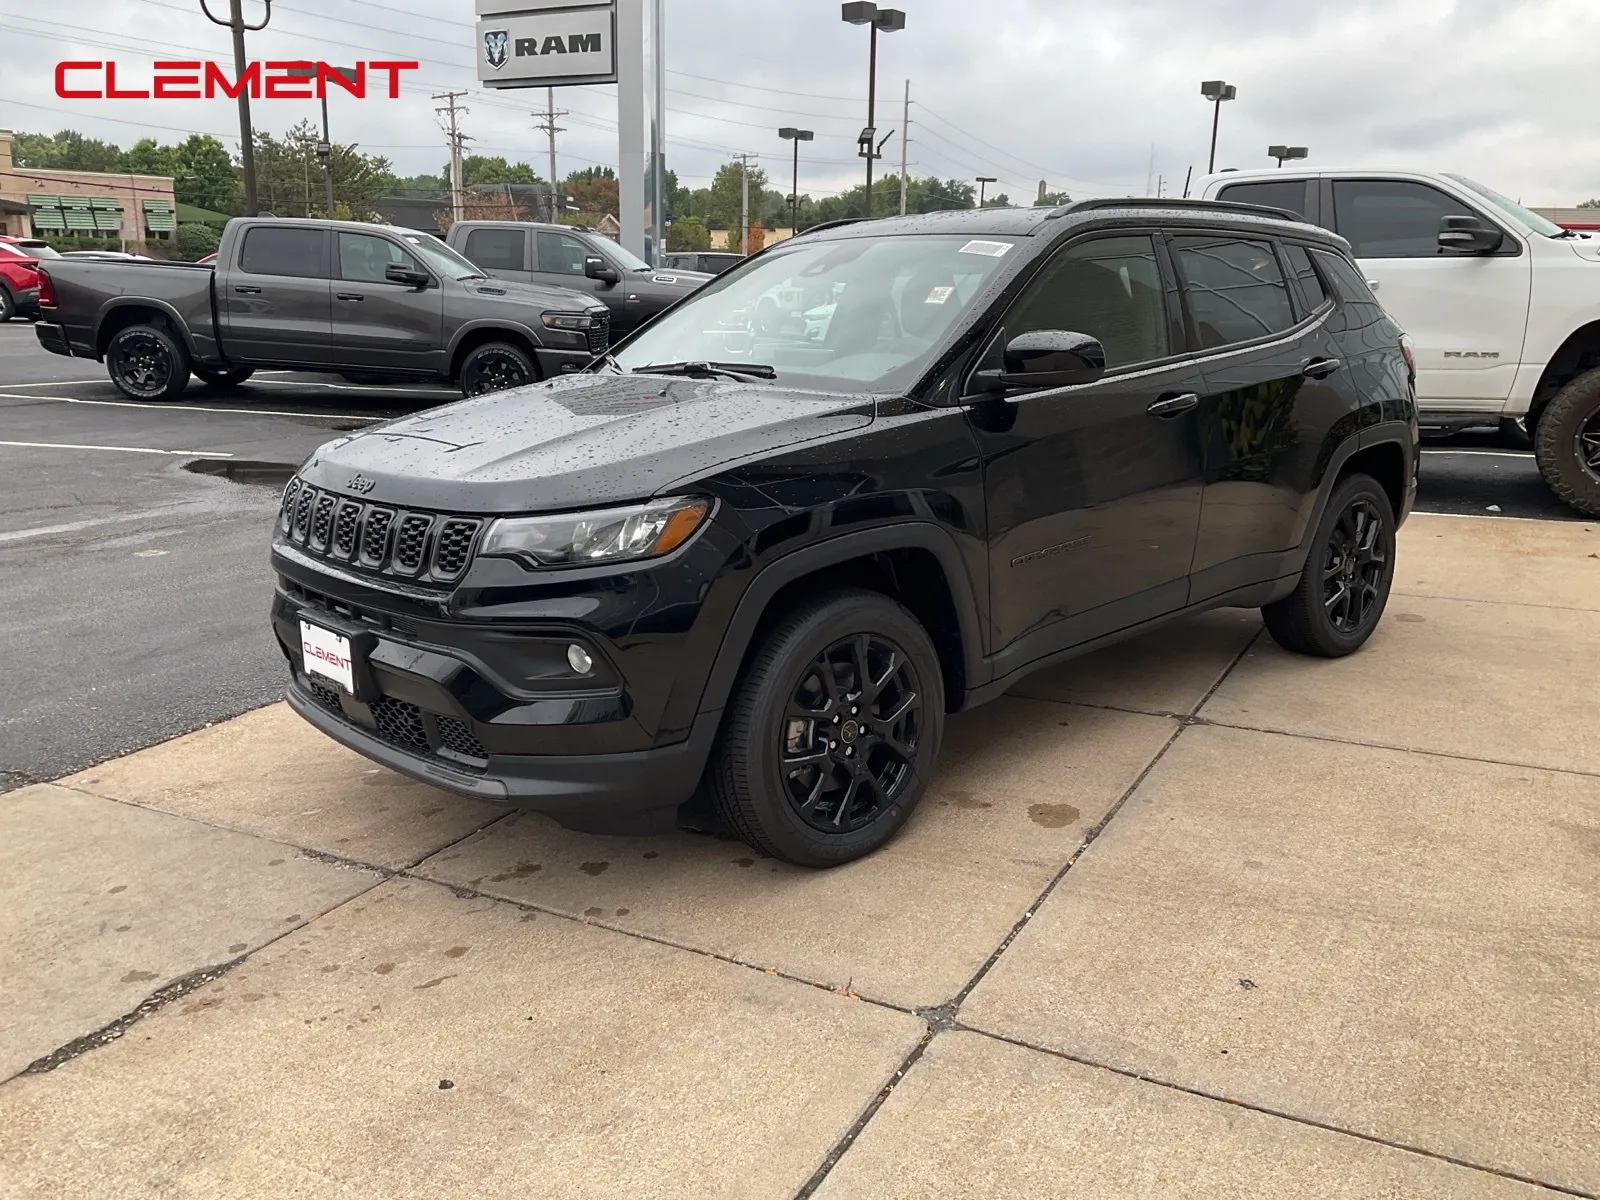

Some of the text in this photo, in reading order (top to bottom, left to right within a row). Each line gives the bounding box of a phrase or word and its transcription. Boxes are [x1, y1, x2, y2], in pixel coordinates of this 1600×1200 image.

[515, 33, 602, 57] RAM
[1444, 351, 1500, 359] RAM
[345, 472, 376, 495] Jeep
[304, 641, 352, 671] CLEMENT
